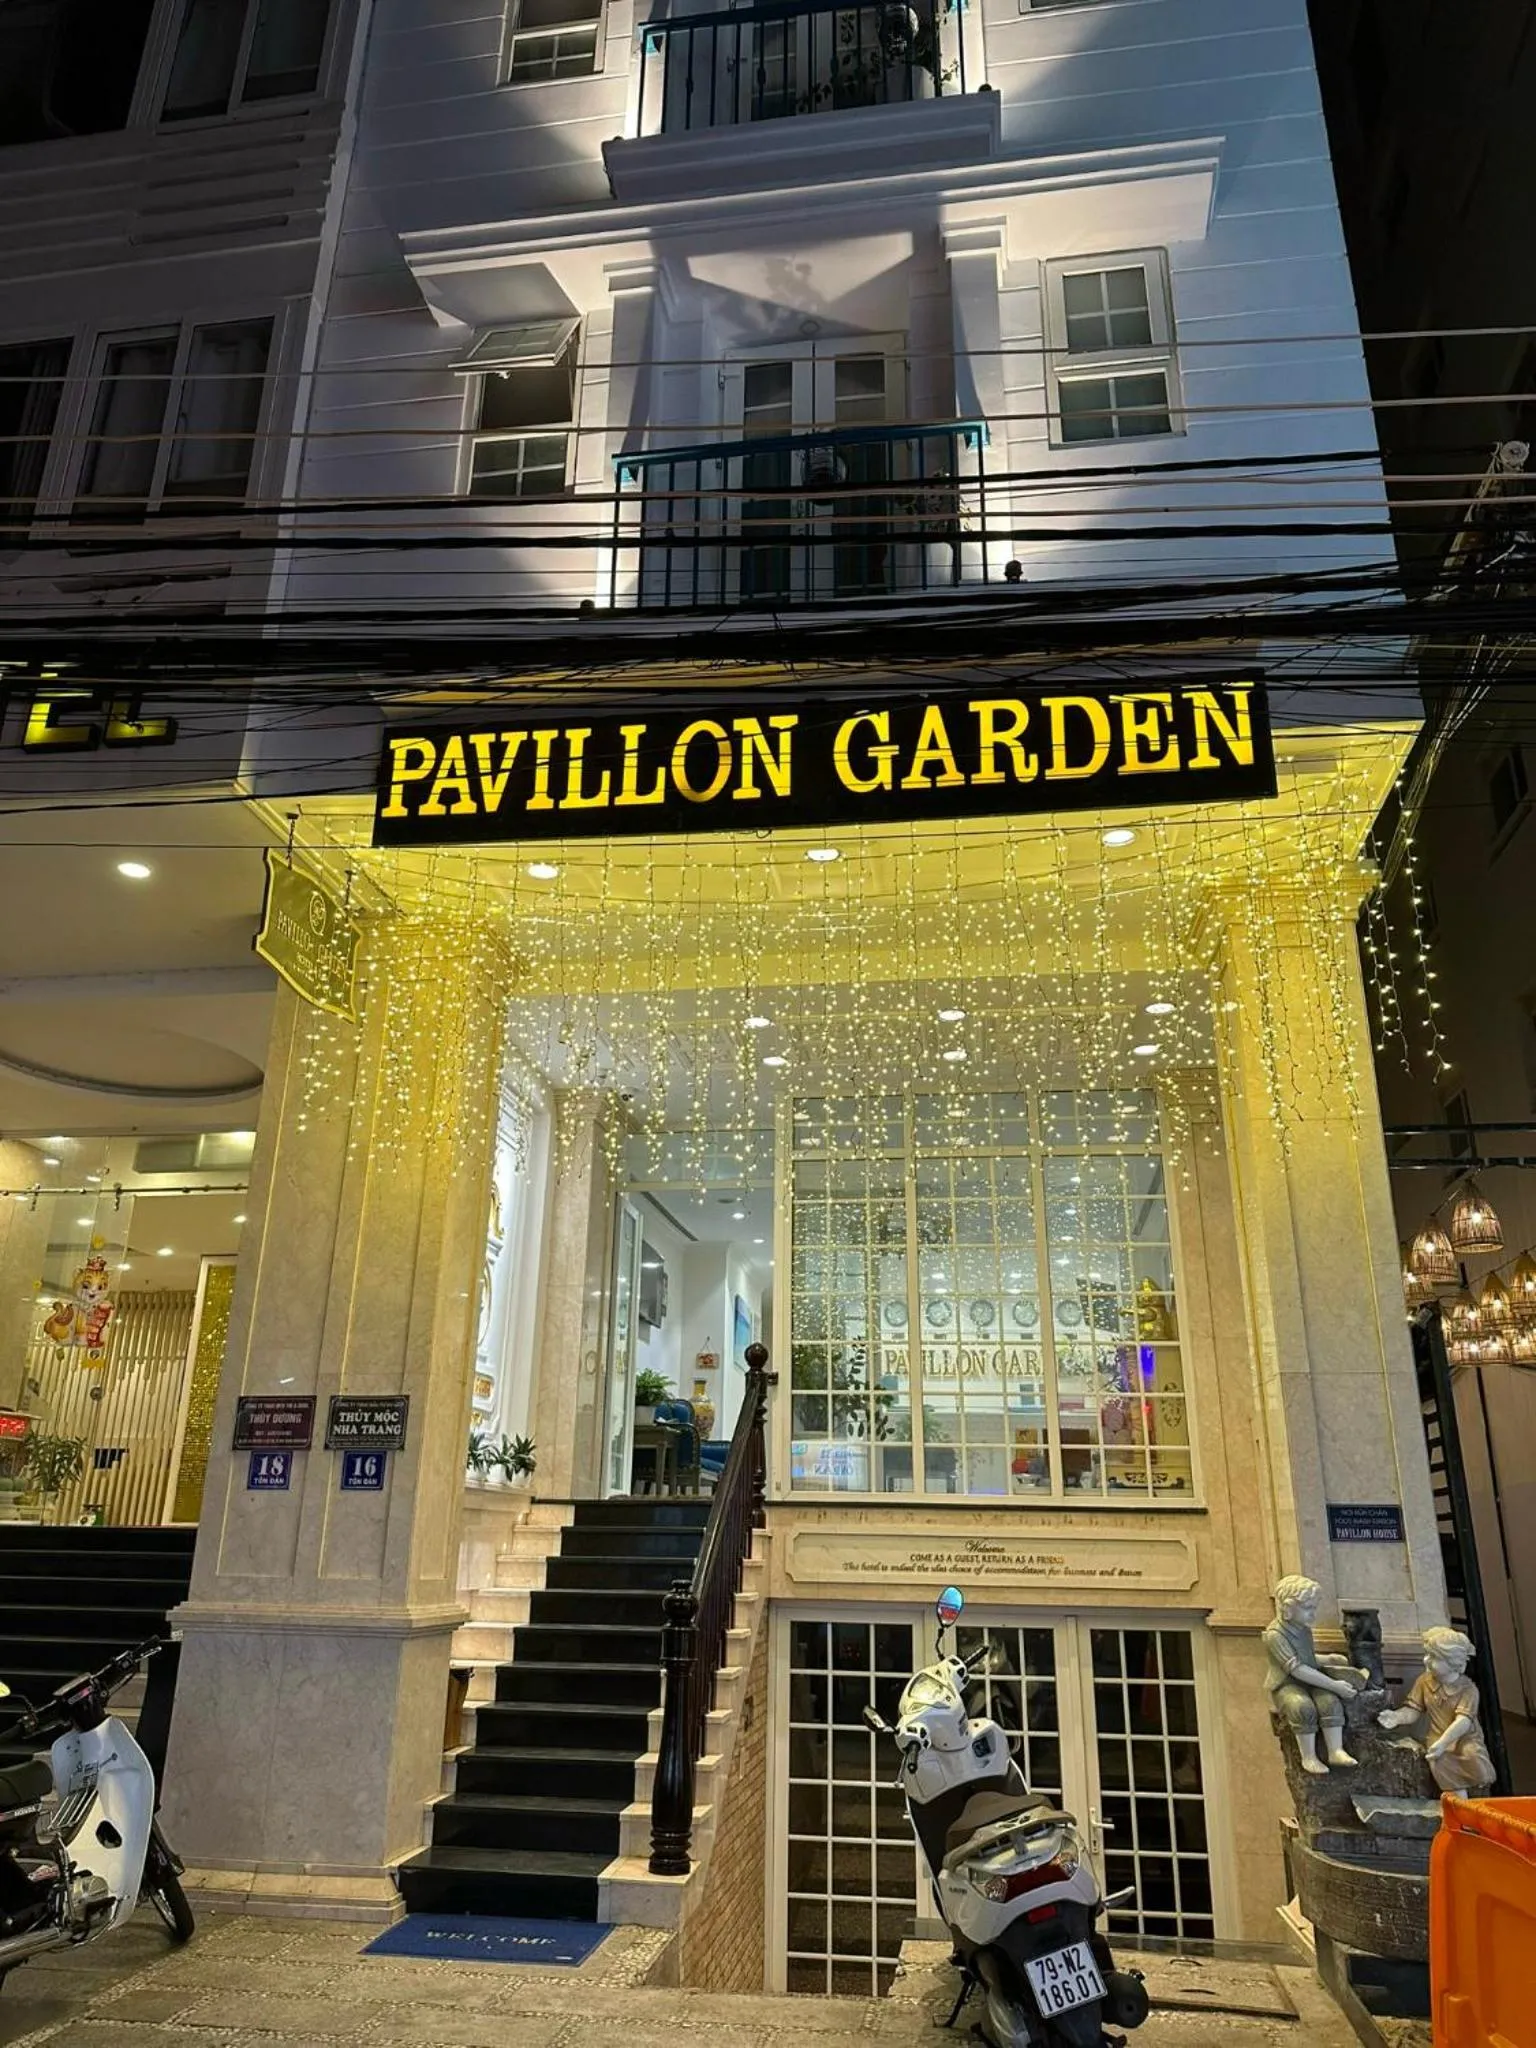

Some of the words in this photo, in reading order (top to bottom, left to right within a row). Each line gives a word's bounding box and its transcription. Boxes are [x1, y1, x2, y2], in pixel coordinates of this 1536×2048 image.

[381, 714, 798, 819] PAVILLON
[833, 682, 1255, 793] GARDEN
[884, 1349, 986, 1377] PAILLON
[333, 1424, 358, 1435] NHA
[361, 1424, 402, 1435] TRANG
[258, 1456, 284, 1476] 18
[352, 1456, 377, 1476] 16
[1336, 1528, 1371, 1539] PAVILLON
[1373, 1529, 1398, 1539] HOUSE
[910, 1553, 932, 1562] COME
[933, 1553, 945, 1562] AS
[946, 1554, 953, 1562] A
[1015, 1555, 1026, 1564] AS
[1028, 1555, 1034, 1564] A
[974, 1564, 985, 1576] of
[1099, 1567, 1118, 1577] and
[1035, 1947, 1086, 1985] 79-N2
[1040, 1969, 1101, 2012] 186.01
